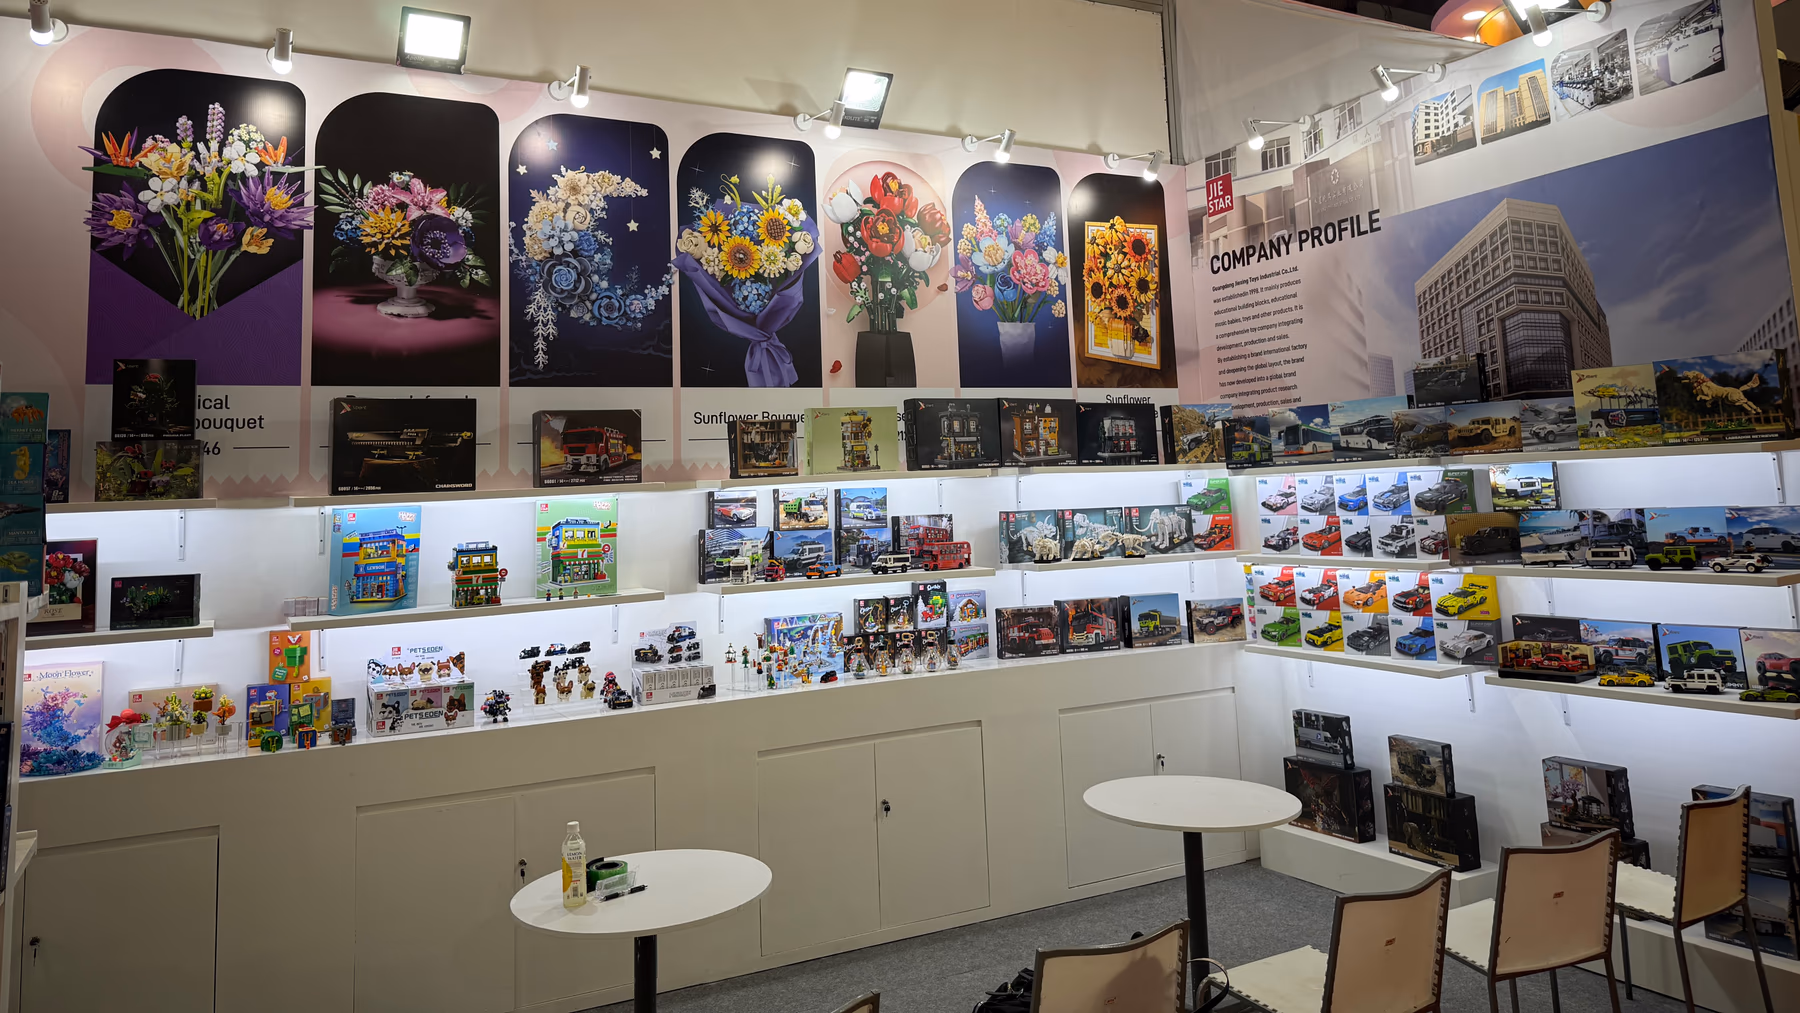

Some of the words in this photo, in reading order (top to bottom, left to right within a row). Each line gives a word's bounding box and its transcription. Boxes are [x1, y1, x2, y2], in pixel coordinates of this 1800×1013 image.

[1208, 180, 1224, 200] JIE
[1208, 195, 1232, 214] STAR
[1210, 232, 1293, 275] COMPANY
[1298, 208, 1382, 252] PROFILE
[1212, 282, 1234, 292] Guangdong
[1260, 270, 1281, 280] Industrial
[1264, 283, 1280, 292] mainly
[1280, 279, 1302, 289] produces
[1214, 305, 1237, 316] educational
[1238, 302, 1255, 311] building
[1271, 292, 1297, 303] educational
[1260, 311, 1272, 319] other
[1219, 328, 1250, 339] comprehensive
[1257, 322, 1278, 332] company
[1278, 317, 1303, 327] integrating
[1244, 338, 1267, 347] production
[1223, 352, 1247, 363] establishing
[1250, 350, 1263, 358] brand
[1263, 346, 1291, 355] international
[1291, 343, 1308, 351] factory
[1226, 366, 1247, 375] deepening
[1254, 361, 1268, 370] global
[1291, 356, 1305, 364] brand
[1236, 376, 1257, 385] developed
[1269, 373, 1283, 381] global
[1283, 370, 1297, 378] brand
[1105, 394, 1151, 405] Sunflower
[1220, 392, 1238, 400] company
[1238, 388, 1260, 397] integrating
[1261, 386, 1277, 395] product
[1278, 383, 1298, 391] research
[197, 394, 230, 410] ical
[693, 411, 758, 425] Sunflower
[762, 411, 805, 424] Bouque
[203, 441, 221, 455] 46
[39, 671, 62, 680] Moon
[64, 669, 90, 679] Flower
[404, 711, 424, 720] PETS
[424, 710, 444, 719] EDEN
